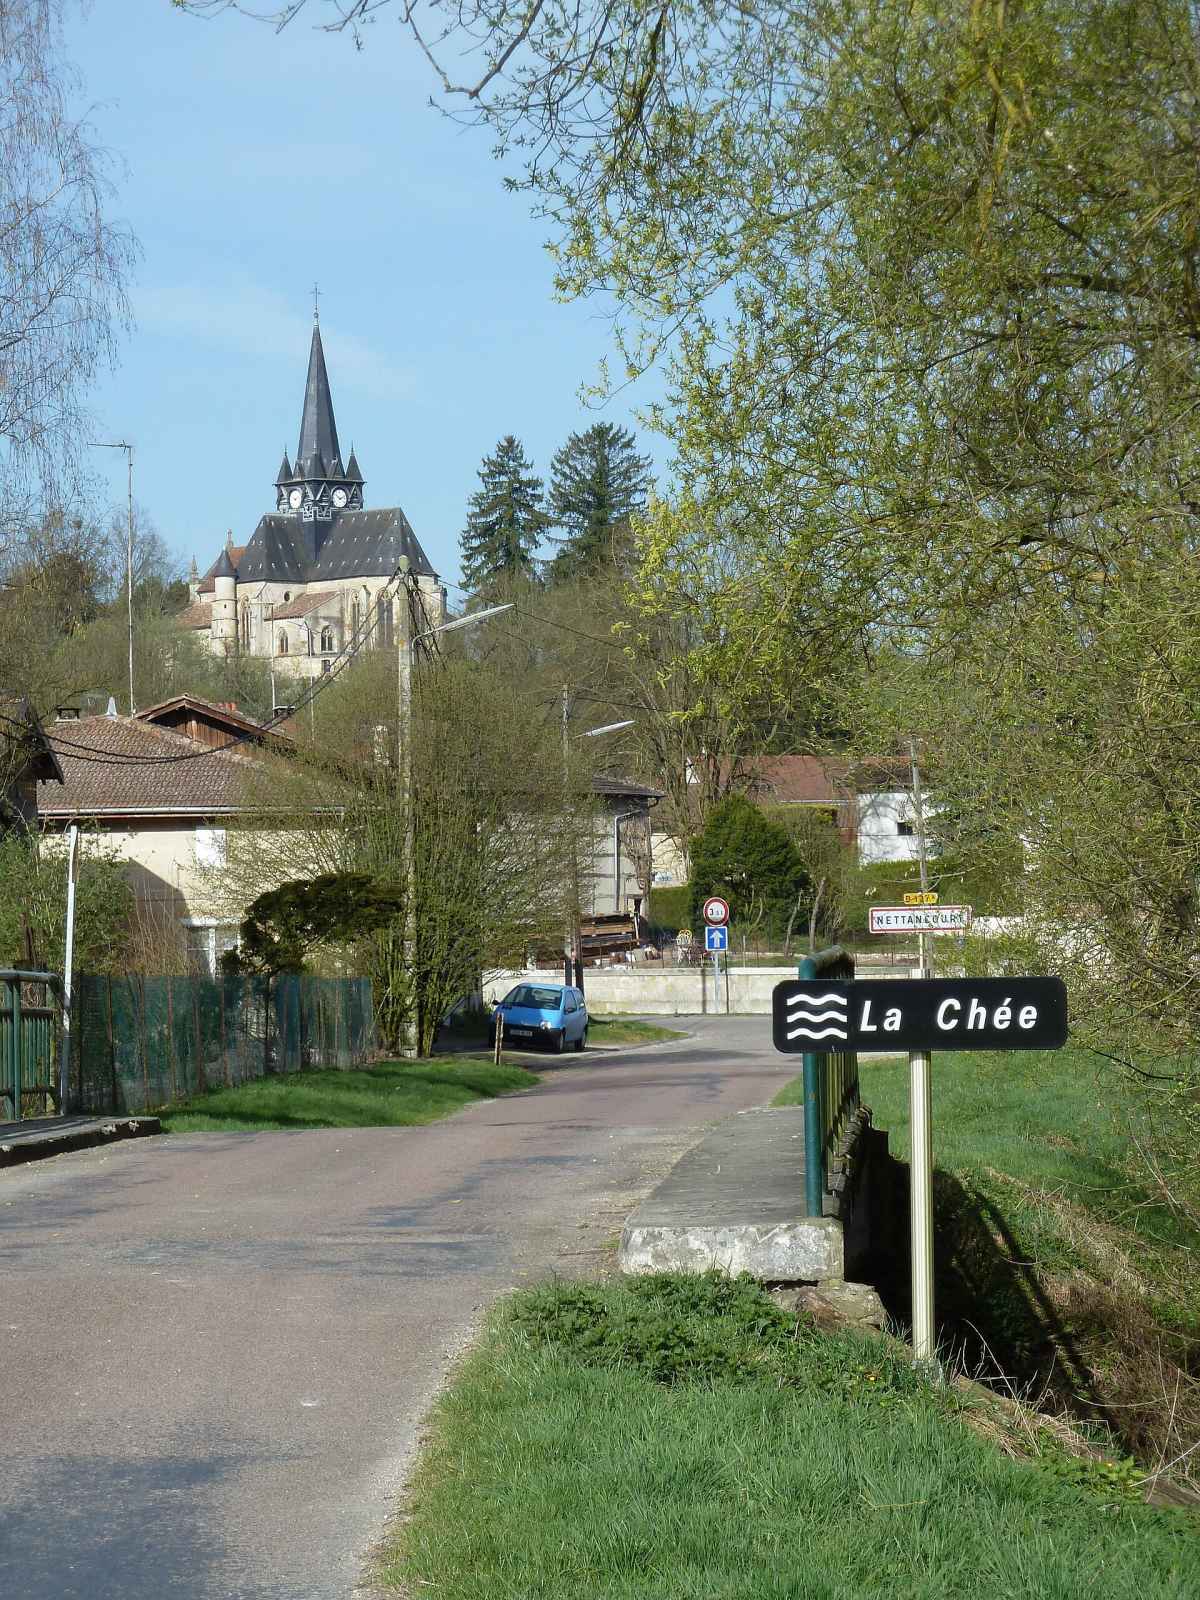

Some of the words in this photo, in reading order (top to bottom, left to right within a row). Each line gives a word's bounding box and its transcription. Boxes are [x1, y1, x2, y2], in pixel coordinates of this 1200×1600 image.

[876, 913, 964, 925] NETTANCOURT
[860, 1000, 902, 1032] La
[936, 997, 1038, 1031] Chée
